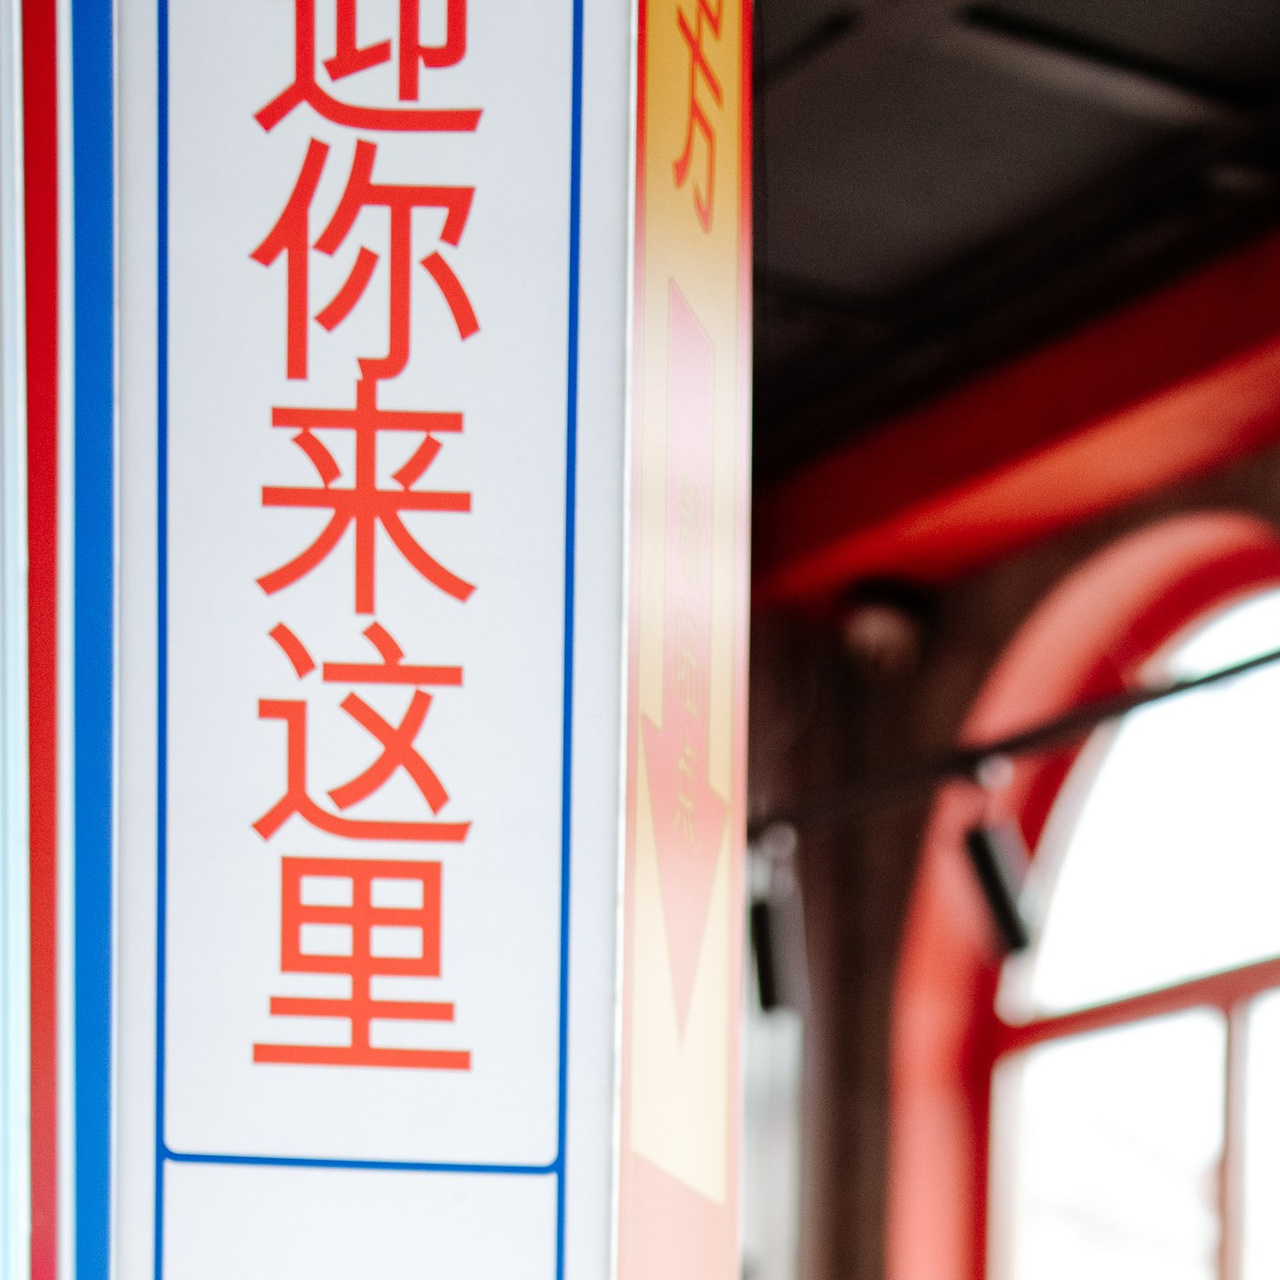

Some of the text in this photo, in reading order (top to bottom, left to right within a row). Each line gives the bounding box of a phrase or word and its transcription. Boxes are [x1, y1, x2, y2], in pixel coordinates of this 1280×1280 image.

[249, 0, 484, 1071] 迎你来这里
